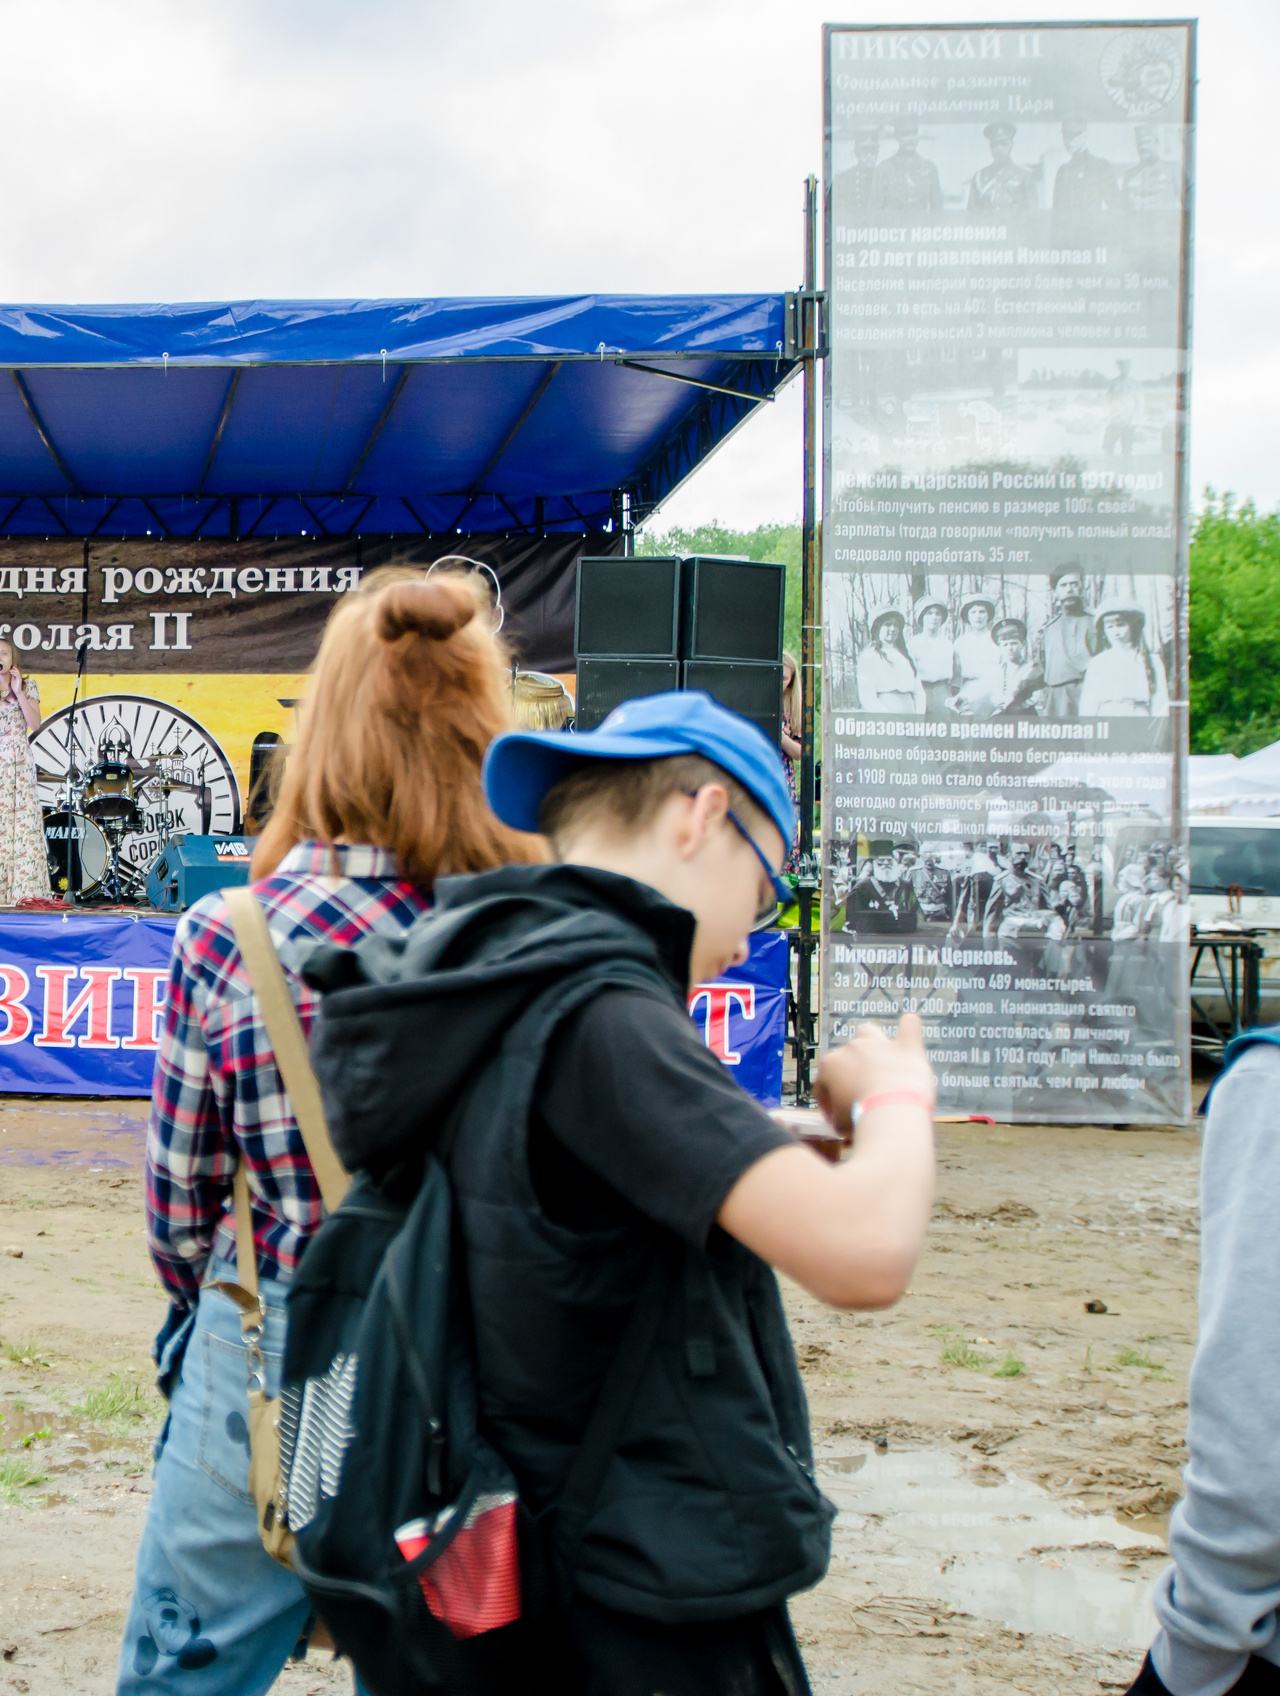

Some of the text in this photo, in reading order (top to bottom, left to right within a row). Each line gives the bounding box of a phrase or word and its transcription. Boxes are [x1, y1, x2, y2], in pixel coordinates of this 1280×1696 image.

[837, 27, 1002, 60] НИКОЛАЙ
[836, 73, 1032, 92] Социальное развитие
[836, 94, 1055, 119] времен правления Царя
[836, 225, 1007, 245] Прирост населения
[836, 246, 1107, 268] за 20 лет правления Николая II
[836, 273, 1140, 294] Население империи возросло более чем на 50
[896, 303, 910, 315] то
[913, 302, 941, 315] есть
[944, 301, 961, 314] на
[994, 297, 1085, 314] Естественный
[1089, 299, 1142, 317] прирост
[836, 322, 1111, 343] населения превысил 3 миллиона человек
[835, 470, 1164, 492] Пенсии в царской России (к 1917 году)
[835, 497, 1136, 517] Чтобы получить пенсию в размере 100% своей
[834, 522, 1128, 541] зарплаты (тогда говорили «получить полный
[834, 546, 1033, 565] следовало проработать 35 лет.
[101, 566, 364, 602] рождения
[149, 612, 193, 650] II
[834, 717, 1109, 739] Образование времен Николая II
[835, 744, 902, 761] Начальное
[905, 745, 987, 764] образование
[990, 746, 1023, 763] было
[1026, 748, 1109, 764] бесплатным
[835, 772, 843, 784] а
[846, 772, 854, 784] с
[857, 769, 886, 784] 1908
[889, 773, 918, 787] года
[922, 774, 943, 786] оно
[946, 774, 982, 787] стало
[835, 796, 896, 810] ежегодно
[899, 796, 982, 812] открывалось
[985, 799, 1038, 814] порядка
[1042, 796, 1057, 812] 10
[135, 808, 186, 836] ОРОК
[835, 818, 843, 833] В
[847, 817, 876, 833] 1913
[880, 822, 907, 837] году
[911, 822, 950, 834] число
[953, 823, 984, 835] школ
[834, 945, 1018, 968] Николай II и Церковь.
[834, 972, 1097, 995] За 20 лет было открыто 489 монастырей.
[833, 997, 1136, 1018] построено 30 300 храмов. Канонизация святого
[979, 1026, 1052, 1040] состоялась
[1055, 1028, 1070, 1040] по
[1073, 1027, 1130, 1044] личному
[971, 1047, 980, 1064] II
[983, 1051, 991, 1064] в
[994, 1047, 1024, 1064] 1903
[1027, 1052, 1058, 1068] году.
[1062, 1048, 1085, 1066] При
[1088, 1049, 1143, 1066] Николае
[1147, 1050, 1181, 1067] было
[942, 1072, 990, 1087] больше
[993, 1075, 1042, 1090] святых,
[1046, 1077, 1071, 1089] чем
[1074, 1077, 1098, 1093] при
[1101, 1076, 1145, 1090] любом
